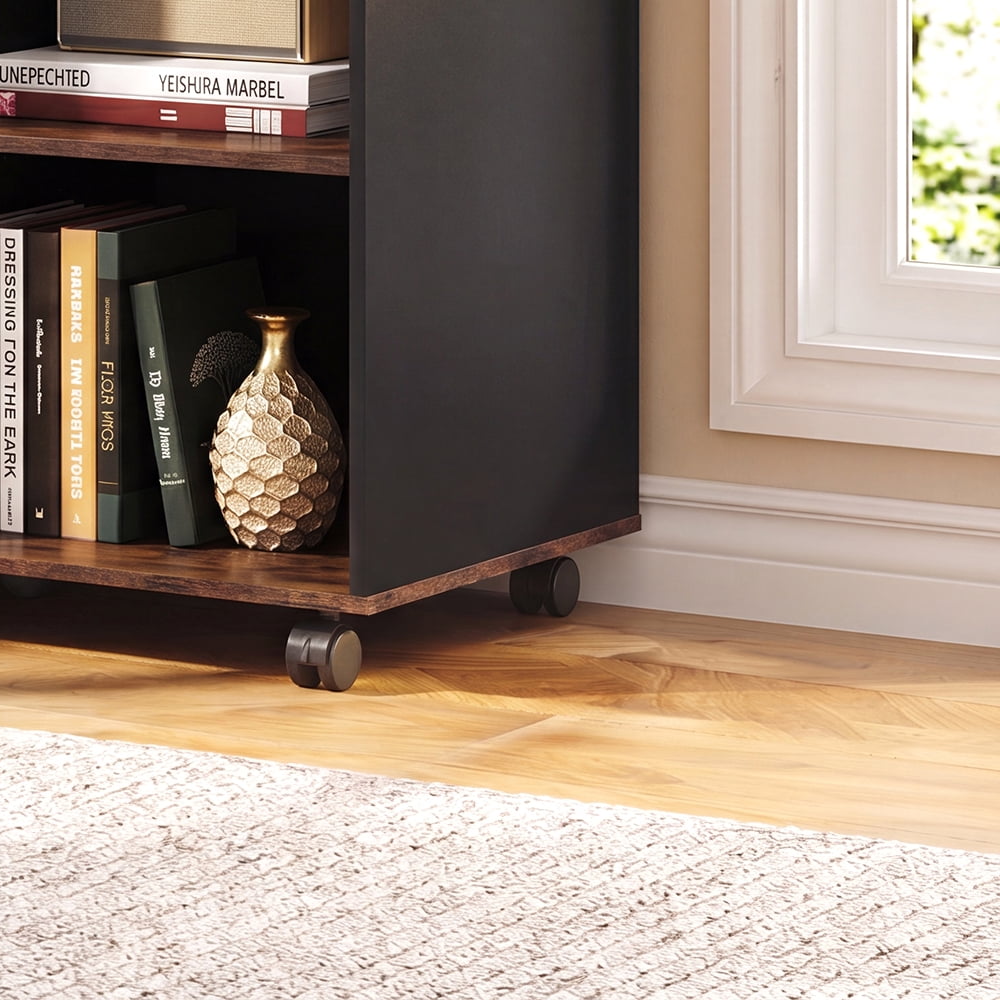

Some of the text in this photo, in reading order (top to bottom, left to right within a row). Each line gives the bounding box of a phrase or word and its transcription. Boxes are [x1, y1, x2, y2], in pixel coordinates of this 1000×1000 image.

[226, 78, 286, 100] MARBEL
[4, 237, 16, 332] DRESSING
[4, 382, 16, 420] THE
[4, 426, 17, 479] EARK
